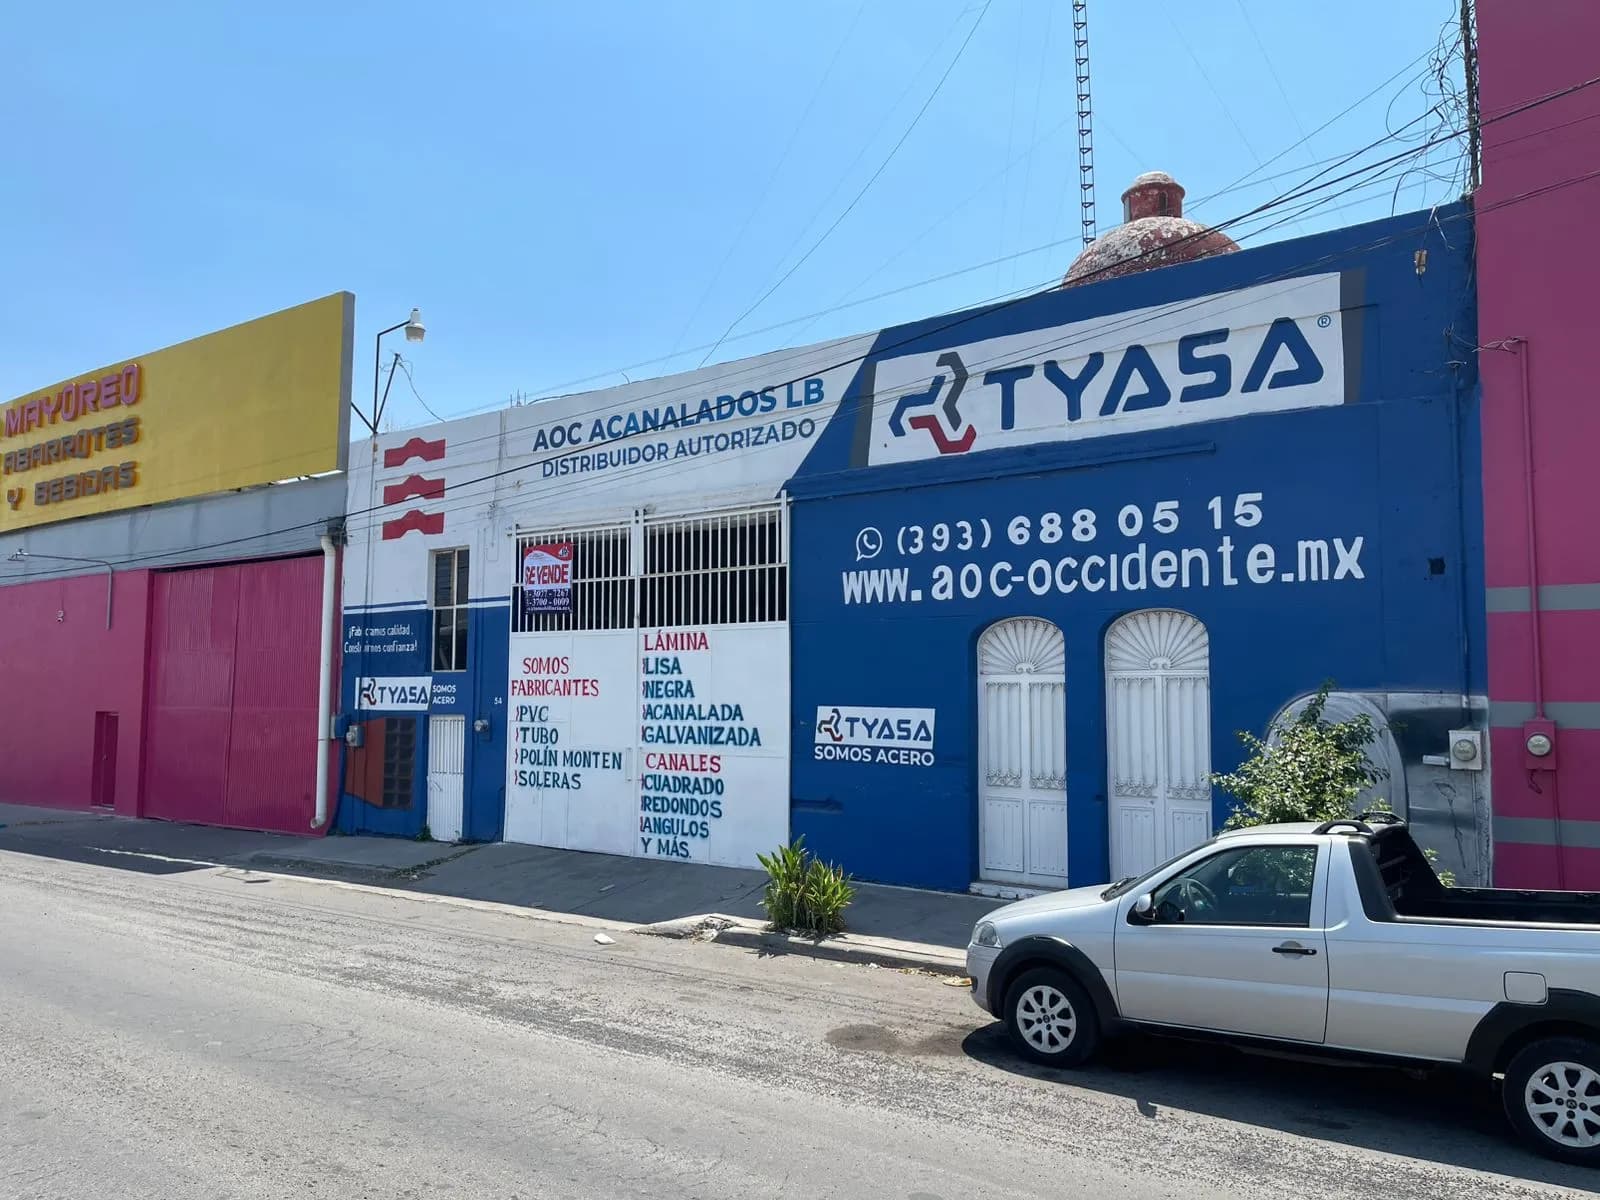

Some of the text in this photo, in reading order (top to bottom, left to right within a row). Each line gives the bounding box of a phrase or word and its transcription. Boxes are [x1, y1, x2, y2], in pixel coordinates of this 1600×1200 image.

[983, 317, 1324, 430] TYASA
[5, 364, 141, 438] MAYOREO
[532, 378, 825, 451] AOC ACANALADOS LB
[3, 416, 141, 475] ABARROTES
[542, 418, 816, 478] DISTRIBUIDOR AUTORIZADO
[7, 461, 139, 511] Y BEBIDAS
[897, 492, 1264, 555] (393) 688 05 15
[525, 564, 569, 585] SE VENDE
[644, 629, 709, 651] LÁMINA
[522, 657, 569, 674] SOMOS
[645, 657, 682, 675] LISA
[378, 685, 457, 704] TYASA SOMOS
[511, 679, 599, 697] FABRICANTES
[644, 680, 695, 698] NEGRA
[432, 696, 456, 704] ACERO
[519, 705, 549, 722] PVC
[645, 704, 744, 721] ACANALADA
[520, 727, 559, 745] TUBO
[644, 726, 761, 746] GALVANIZADA
[845, 717, 932, 741] TYASA
[520, 745, 622, 770] POLÍN MONTEN
[645, 753, 721, 773] CANALES
[814, 745, 935, 766] SOMOS ACERO
[518, 770, 582, 789] SOLERAS
[643, 774, 724, 795] CUADRADO
[643, 796, 722, 818] REDONDOS
[642, 817, 709, 838] ANGULOS
[641, 836, 652, 853] Y
